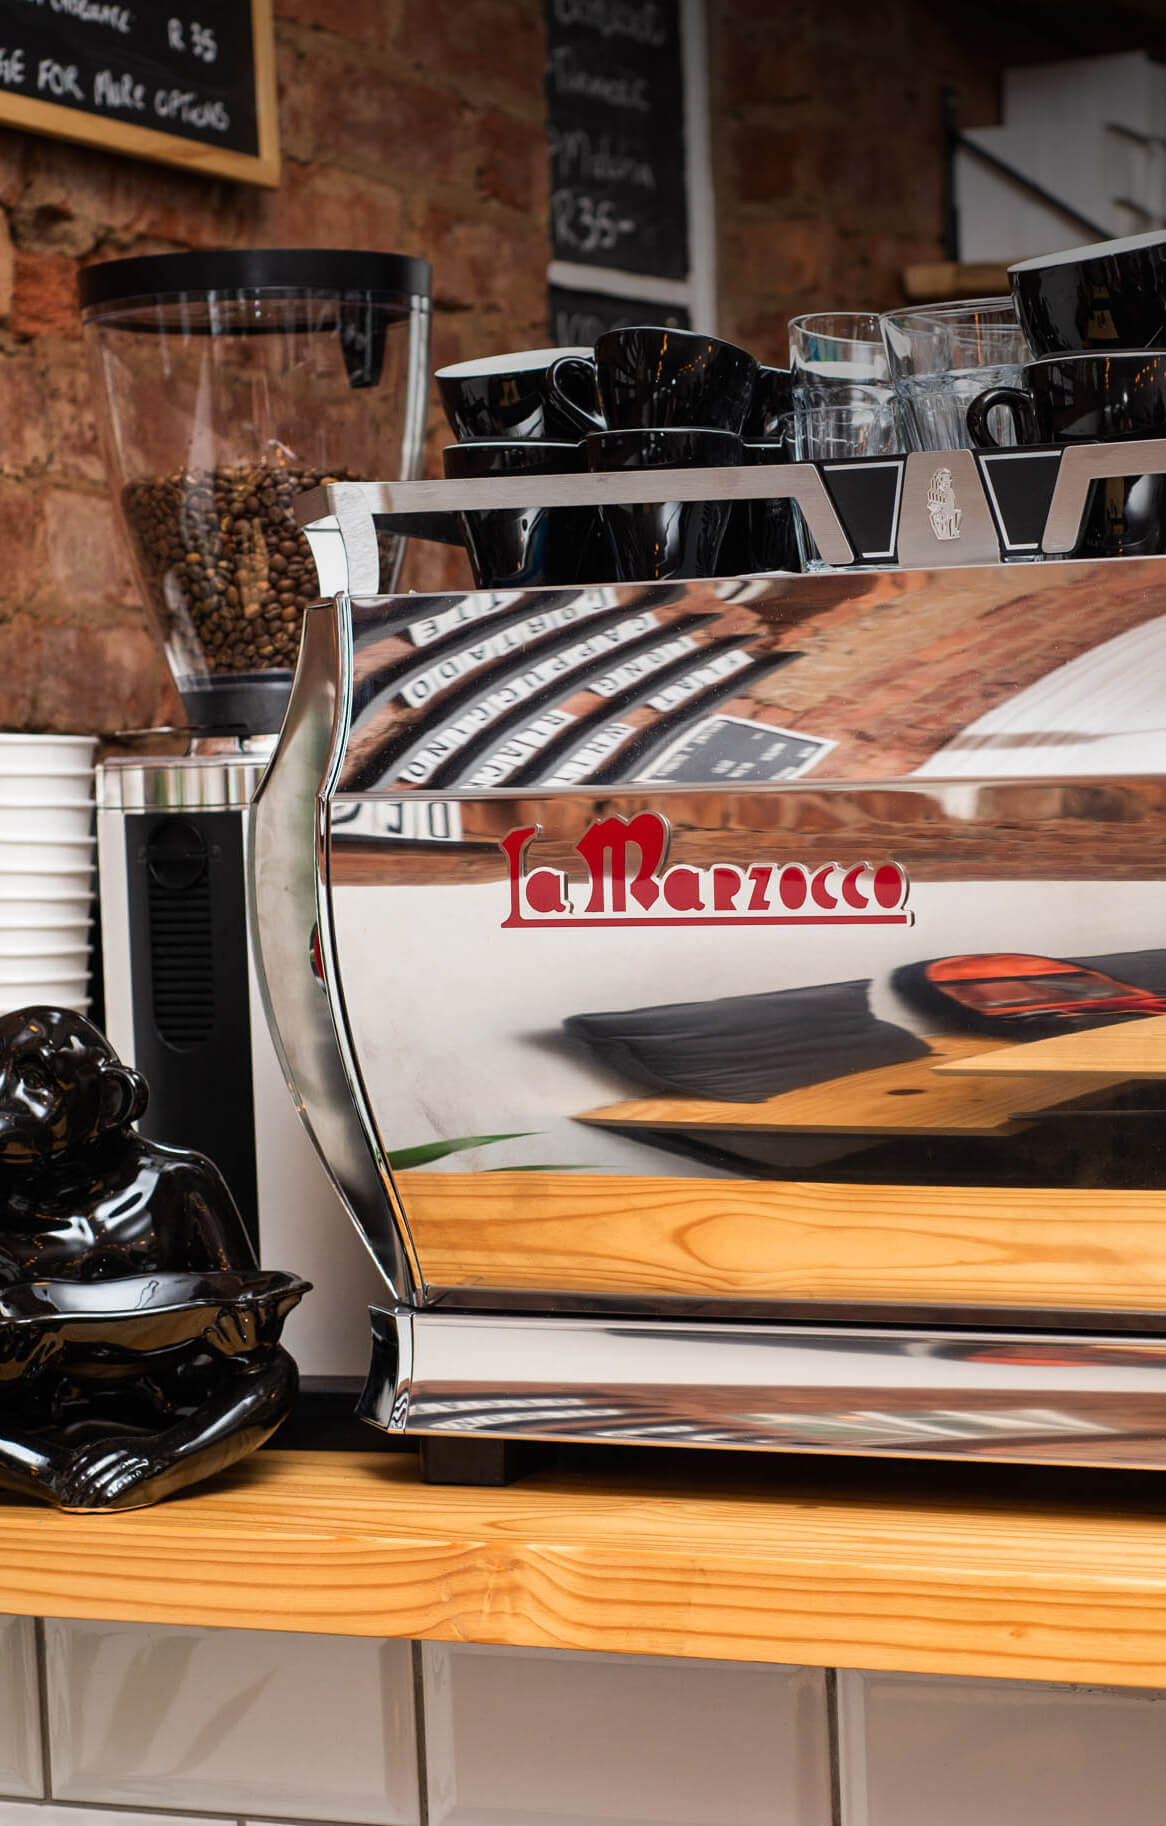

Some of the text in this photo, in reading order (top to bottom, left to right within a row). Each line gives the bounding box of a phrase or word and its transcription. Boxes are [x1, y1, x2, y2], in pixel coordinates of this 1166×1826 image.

[37, 58, 85, 101] FOR
[408, 613, 656, 779] CAPPUCCINO
[499, 825, 573, 927] La
